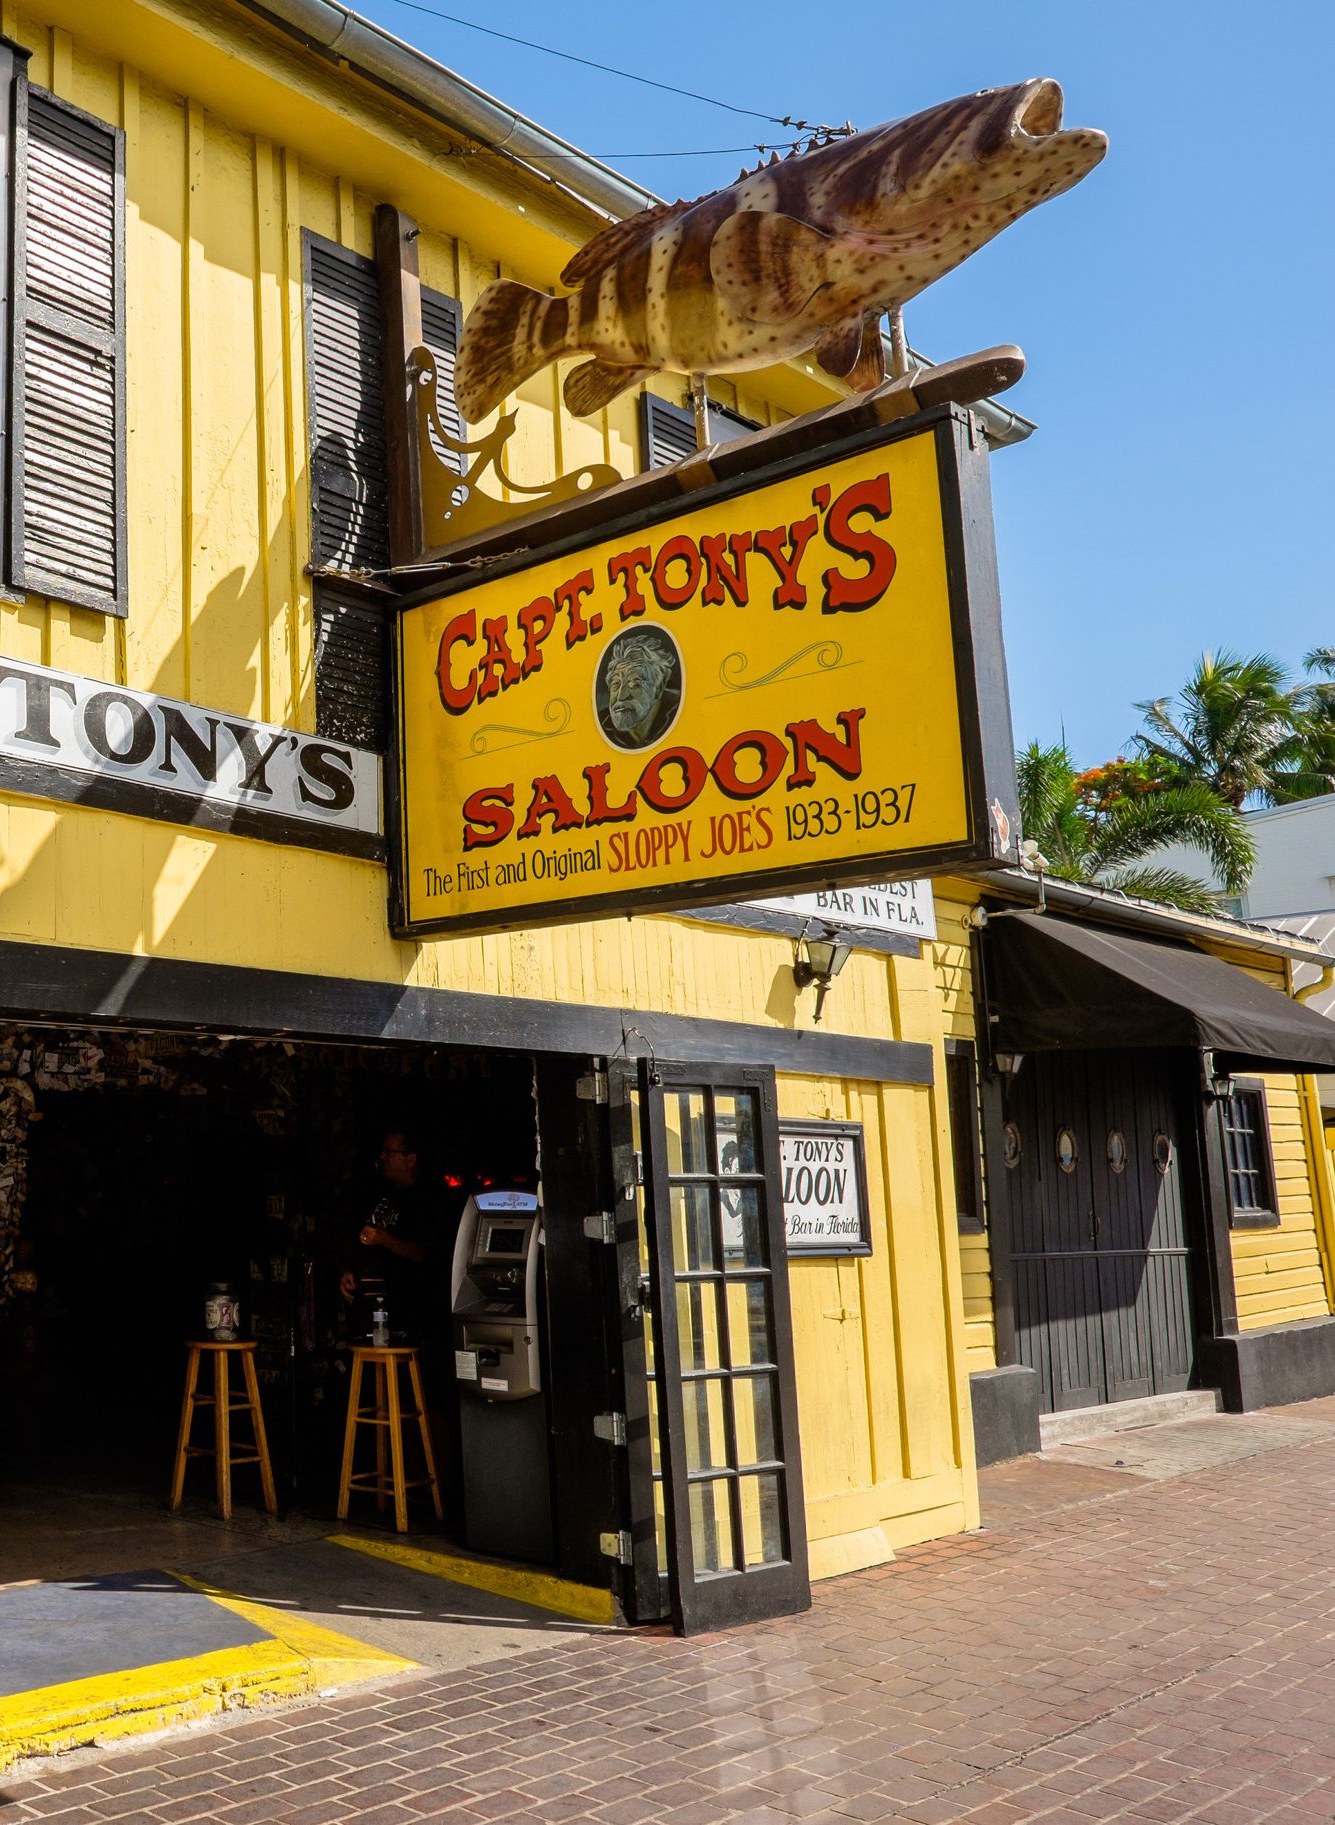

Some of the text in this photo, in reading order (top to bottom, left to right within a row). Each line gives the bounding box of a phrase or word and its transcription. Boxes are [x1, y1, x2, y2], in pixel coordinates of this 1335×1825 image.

[435, 472, 898, 716] CAPT. TONY'S
[461, 707, 867, 852] SALOON
[423, 783, 917, 897] The First and Original SLOPPY JOE'S 1933-1937
[816, 891, 856, 914] BAR
[861, 895, 880, 918] IN
[886, 900, 924, 926] FLA.
[783, 1165, 848, 1206] LOON
[789, 1214, 813, 1237] Bar
[814, 1217, 825, 1235] in
[826, 1214, 859, 1236] Florida
